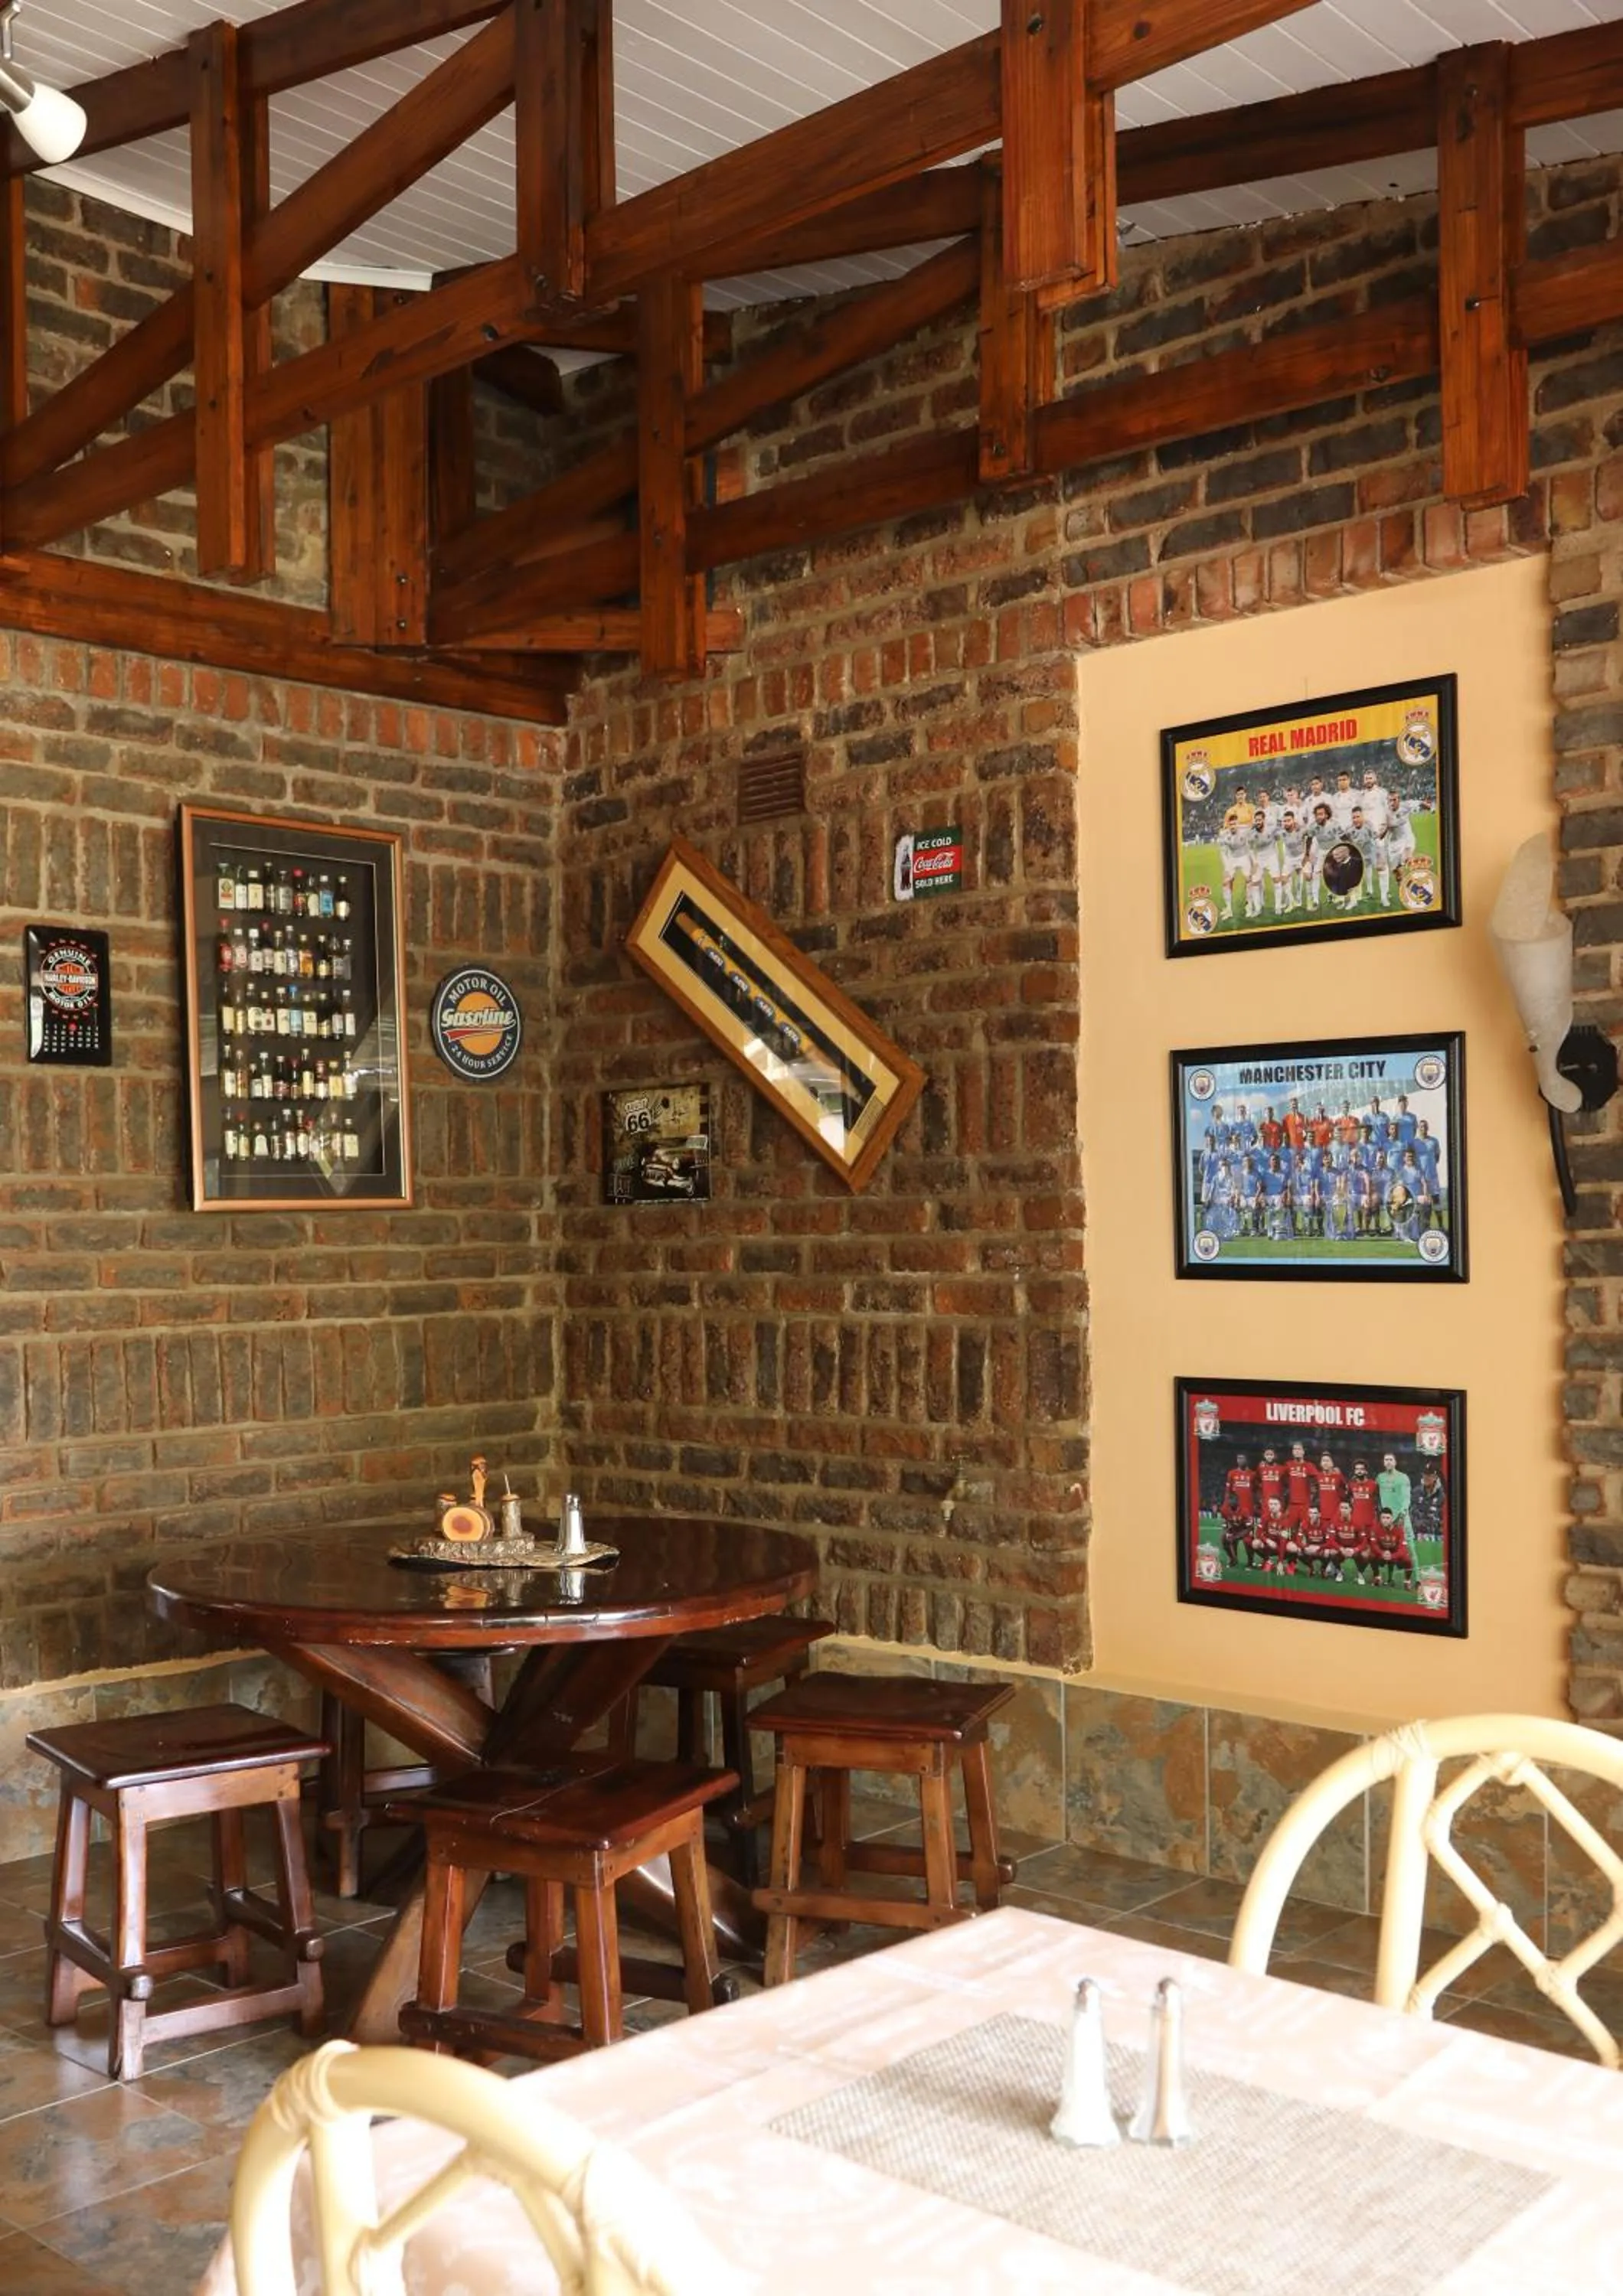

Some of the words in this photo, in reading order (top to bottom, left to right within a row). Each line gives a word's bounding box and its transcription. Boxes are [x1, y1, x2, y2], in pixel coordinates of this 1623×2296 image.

[1249, 734, 1286, 757] REAL
[1290, 719, 1358, 750] MADRID
[917, 840, 929, 850] ICE
[931, 837, 952, 848] COLD
[915, 878, 933, 889] SOLD
[935, 874, 953, 885] HERE
[77, 995, 93, 1008] OIL
[449, 977, 488, 1004] MOTOR
[490, 986, 507, 1006] OIL
[441, 1008, 516, 1028] Gasoline
[462, 1055, 486, 1069] HOUR
[487, 1033, 514, 1067] SERVICE
[1239, 1062, 1344, 1084] MANCHESTER
[1349, 1060, 1387, 1079] CITY
[628, 1111, 650, 1133] 66
[1265, 1401, 1344, 1425] LIVERPOOL
[1346, 1407, 1366, 1427] FC
